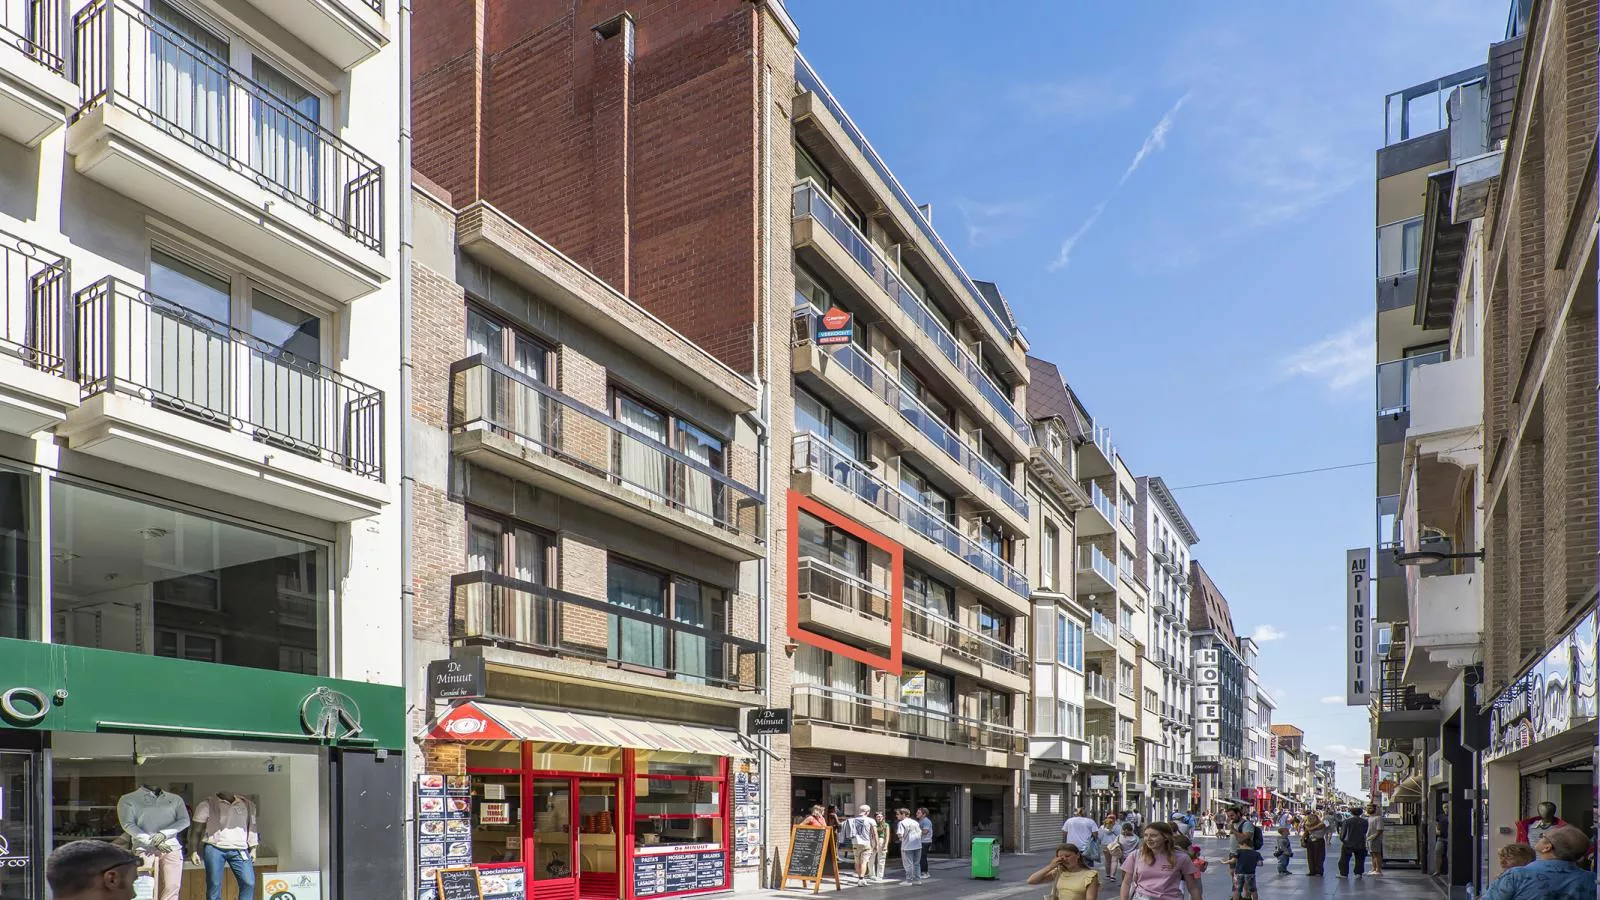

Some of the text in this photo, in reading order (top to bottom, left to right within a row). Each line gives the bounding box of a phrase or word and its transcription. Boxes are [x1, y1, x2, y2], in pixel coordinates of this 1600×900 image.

[1352, 559, 1366, 571] AU
[1354, 574, 1363, 694] PINGOUIN
[448, 661, 462, 672] De
[436, 673, 472, 684] Minuut
[1204, 651, 1217, 736] HOTEL
[763, 710, 775, 718] De
[755, 718, 783, 726] Minuut
